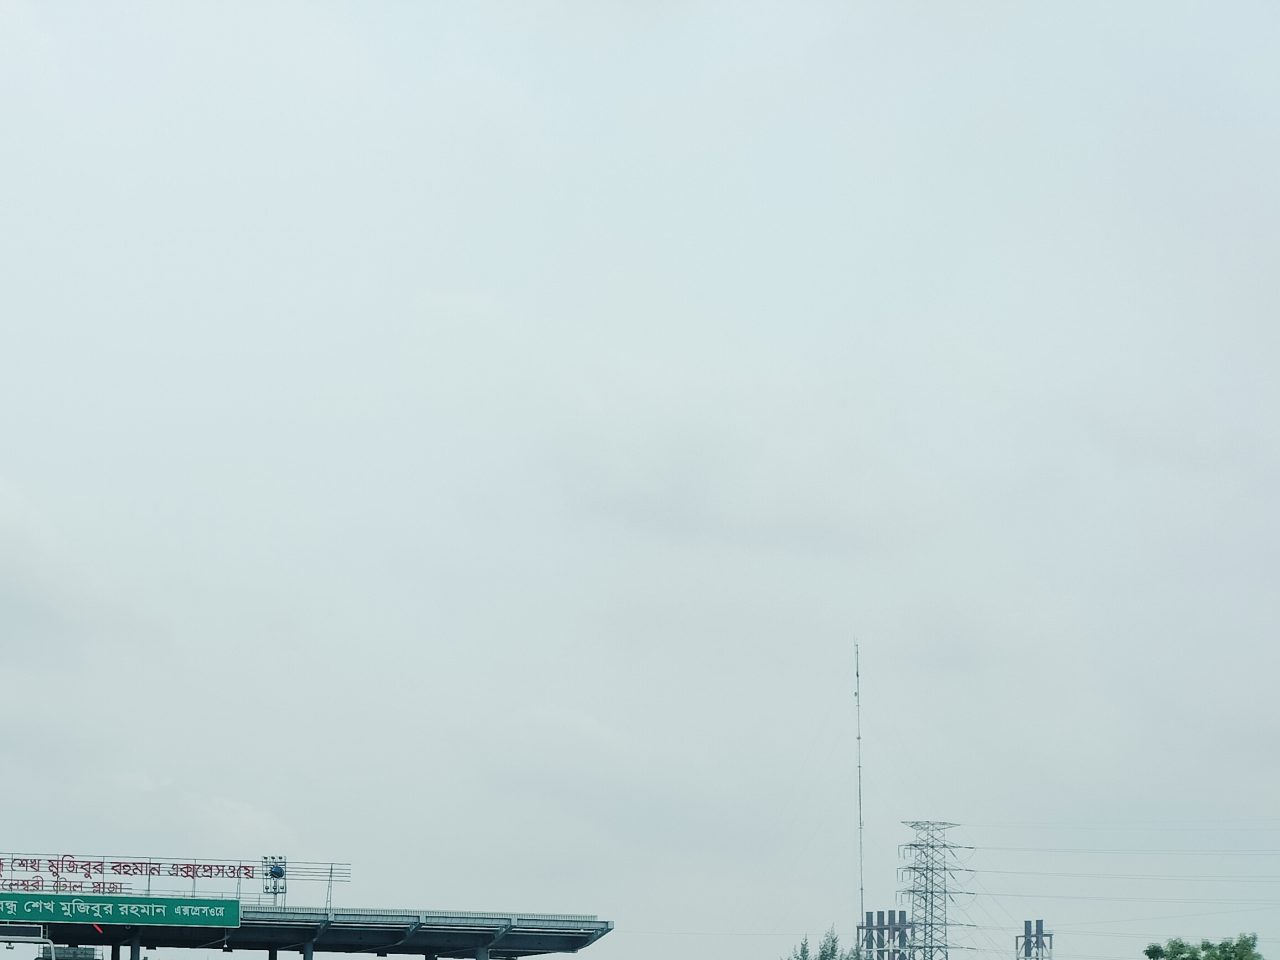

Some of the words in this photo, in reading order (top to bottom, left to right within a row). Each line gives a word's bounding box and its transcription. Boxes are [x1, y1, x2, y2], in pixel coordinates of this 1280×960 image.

[11, 858, 41, 873] শেখ
[48, 854, 105, 879] মুজিবুর
[110, 861, 161, 877] রহমান
[52, 877, 83, 893] টোল
[24, 901, 54, 914] শেখ
[60, 898, 113, 918] মুজিবুর
[118, 902, 167, 918] রহমান
